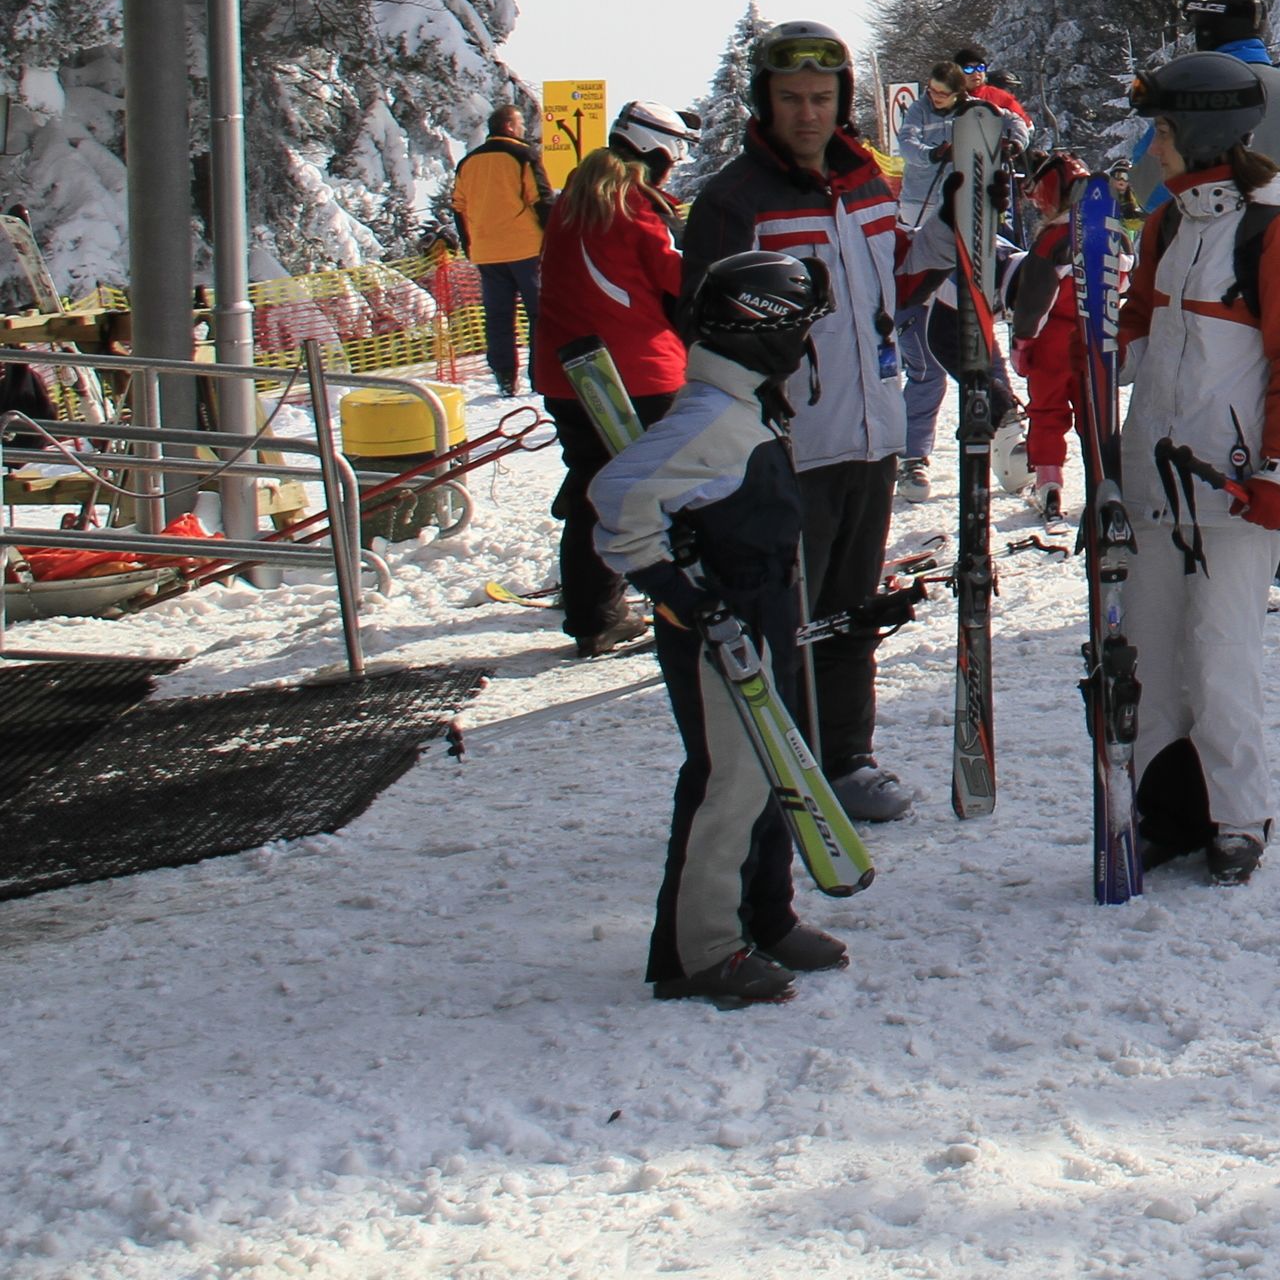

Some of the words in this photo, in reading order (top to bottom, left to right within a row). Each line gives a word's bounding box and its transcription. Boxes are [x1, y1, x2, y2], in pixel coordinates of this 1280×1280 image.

[1175, 91, 1242, 109] uvex
[972, 149, 985, 294] ROSSIGNOL
[738, 292, 791, 316] MAPLUS
[1072, 253, 1091, 319] PLUS
[804, 794, 841, 858] elan
